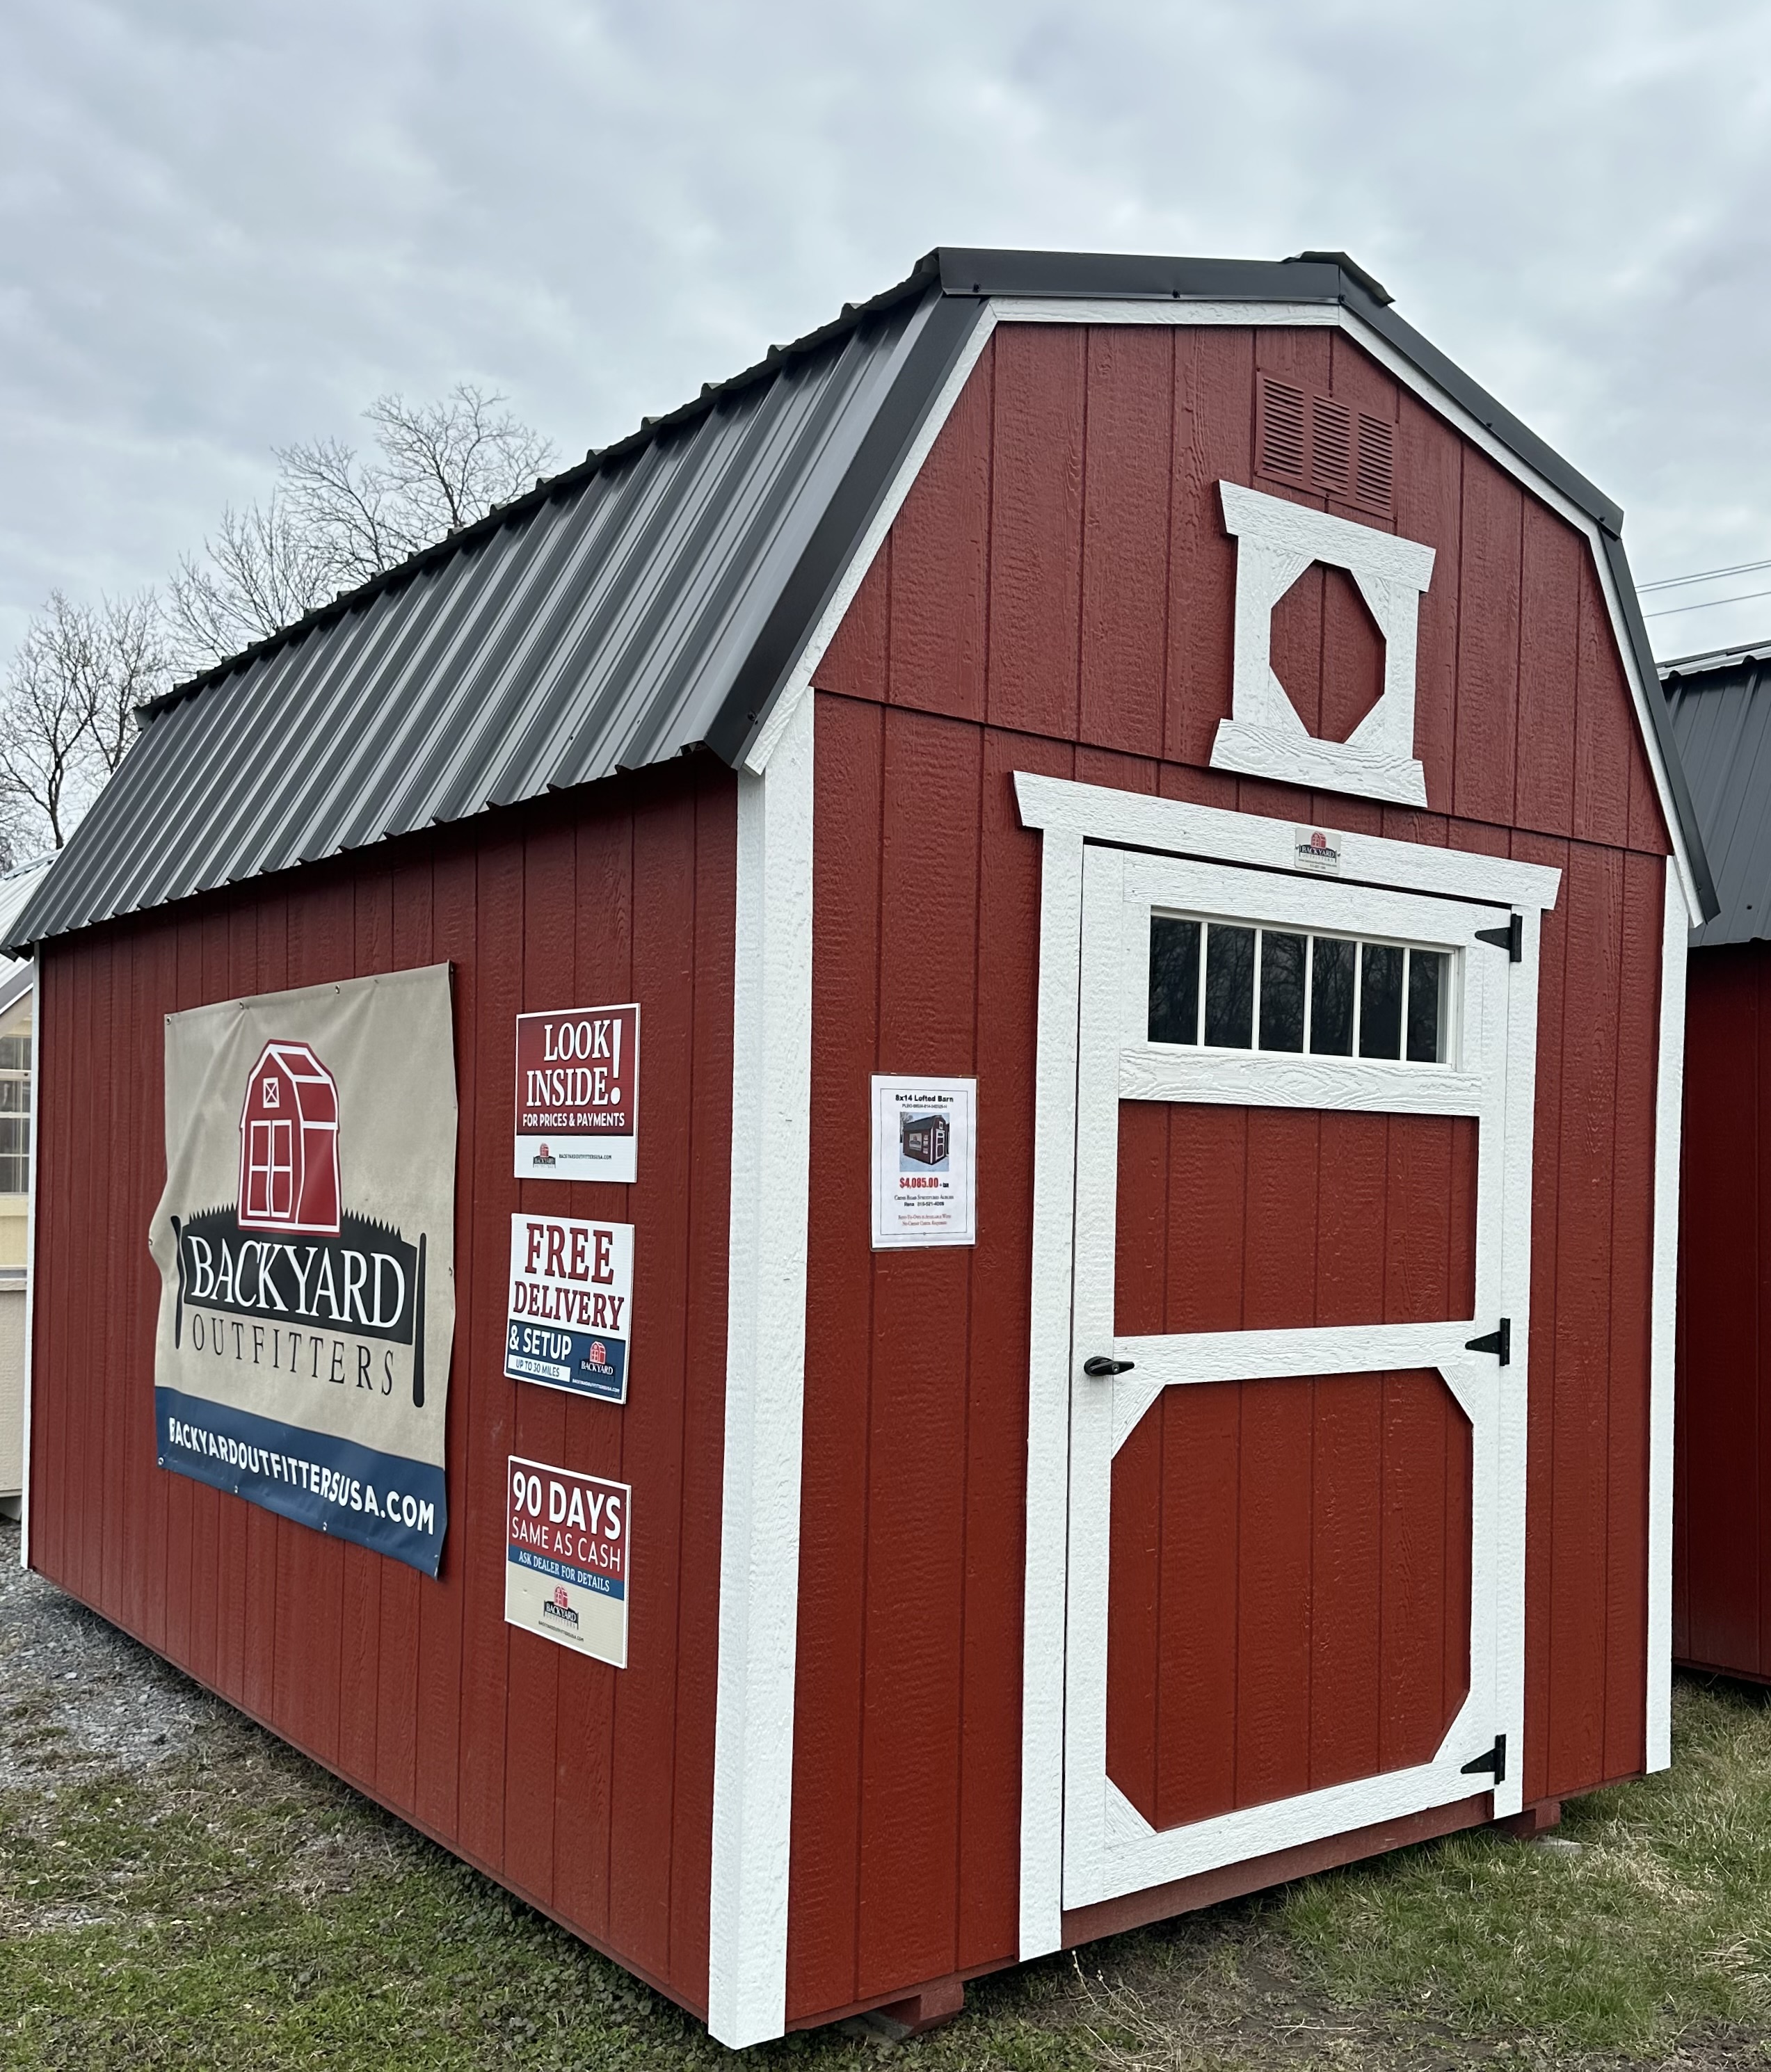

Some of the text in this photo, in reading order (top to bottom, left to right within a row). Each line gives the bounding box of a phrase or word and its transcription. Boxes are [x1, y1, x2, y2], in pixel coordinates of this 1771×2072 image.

[1301, 846, 1335, 858] BACKYARD
[544, 1019, 611, 1061] LOOK
[523, 1113, 625, 1127] FOR PRICES & PAYMENTS
[899, 1177, 938, 1189] $4,085.00
[524, 1222, 614, 1285] FREE
[188, 1236, 405, 1328] BACKYARD
[513, 1280, 625, 1331] DELIVERY
[193, 1313, 394, 1396] OUTFITTERS
[509, 1324, 572, 1360] & SETUP
[515, 1358, 560, 1377] UP TO 30 MILES
[581, 1360, 614, 1375] BACKYARD
[169, 1417, 434, 1535] BACKYARDOUTFITTERSUSA.COM
[513, 1471, 621, 1540] 90 DAYS
[512, 1516, 621, 1572] SAME AS CASH
[518, 1550, 610, 1592] ASK DEALER FOR DETAILS
[546, 1603, 577, 1621] BACKYARD
